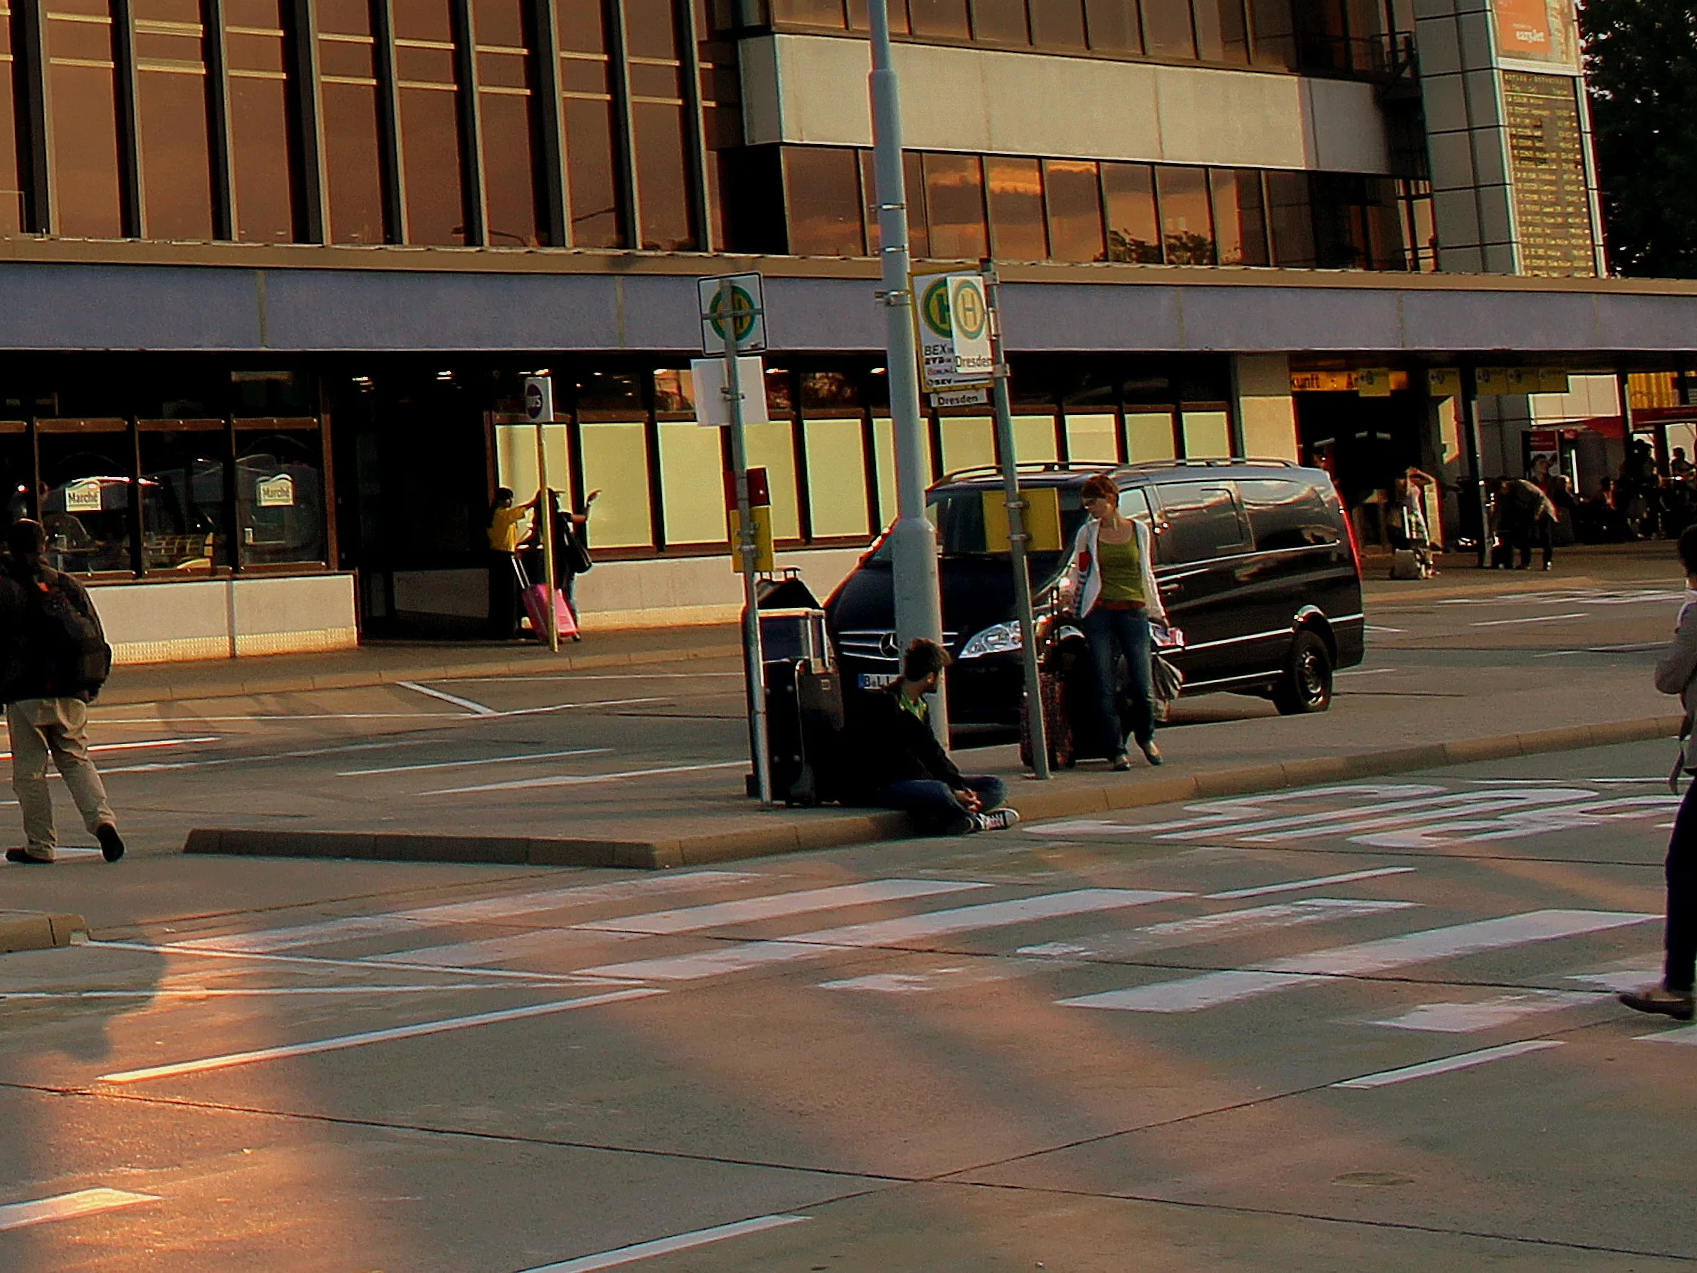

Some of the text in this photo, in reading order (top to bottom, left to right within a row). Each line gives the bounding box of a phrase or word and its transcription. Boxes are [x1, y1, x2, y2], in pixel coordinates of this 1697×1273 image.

[955, 355, 993, 368] Dresden
[938, 393, 978, 405] Dresden
[68, 490, 99, 504] Marché
[261, 485, 291, 499] Marché
